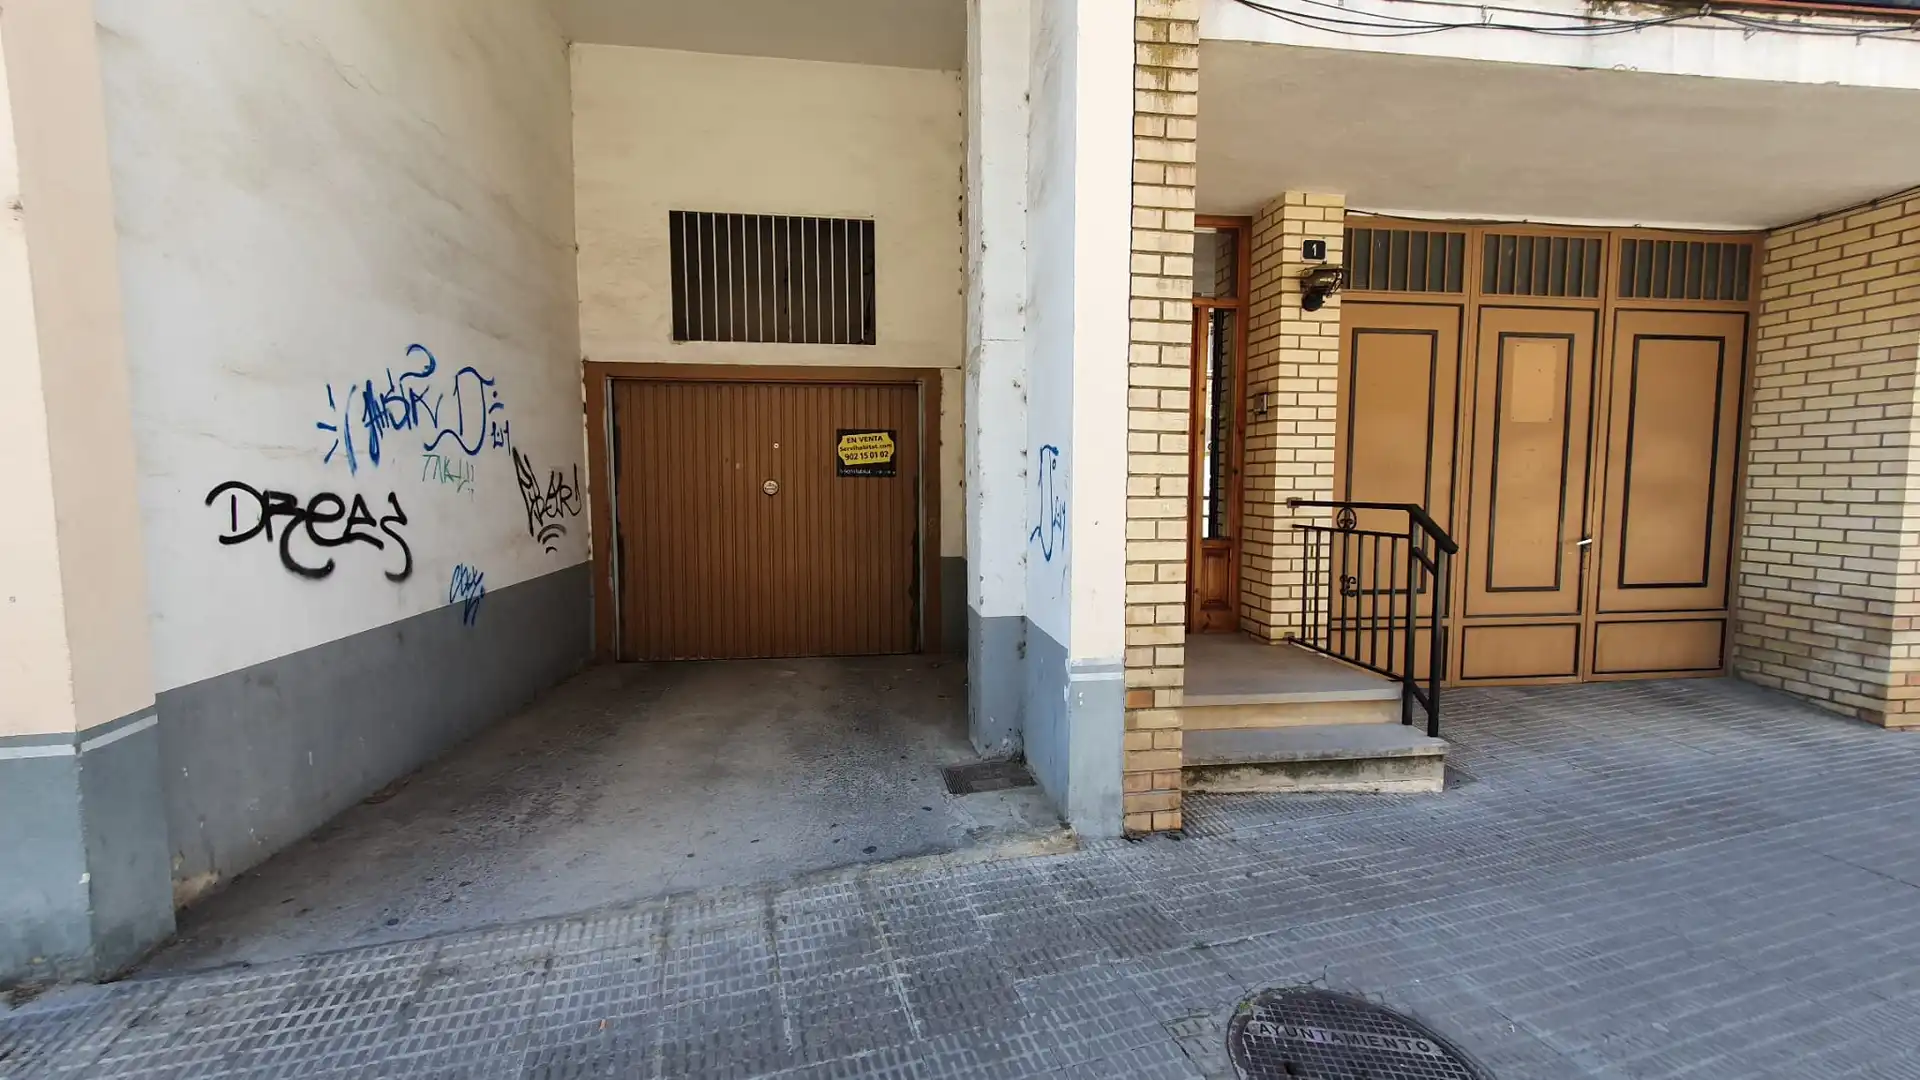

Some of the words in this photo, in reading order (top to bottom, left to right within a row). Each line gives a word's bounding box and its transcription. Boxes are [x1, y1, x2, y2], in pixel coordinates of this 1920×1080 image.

[1312, 243, 1317, 257] 1
[859, 435, 883, 443] VENTA
[844, 453, 859, 461] 902
[860, 452, 869, 460] 15
[869, 451, 878, 459] 01
[880, 450, 889, 458] 02
[1258, 1022, 1432, 1053] AYUNTAMIENTO
